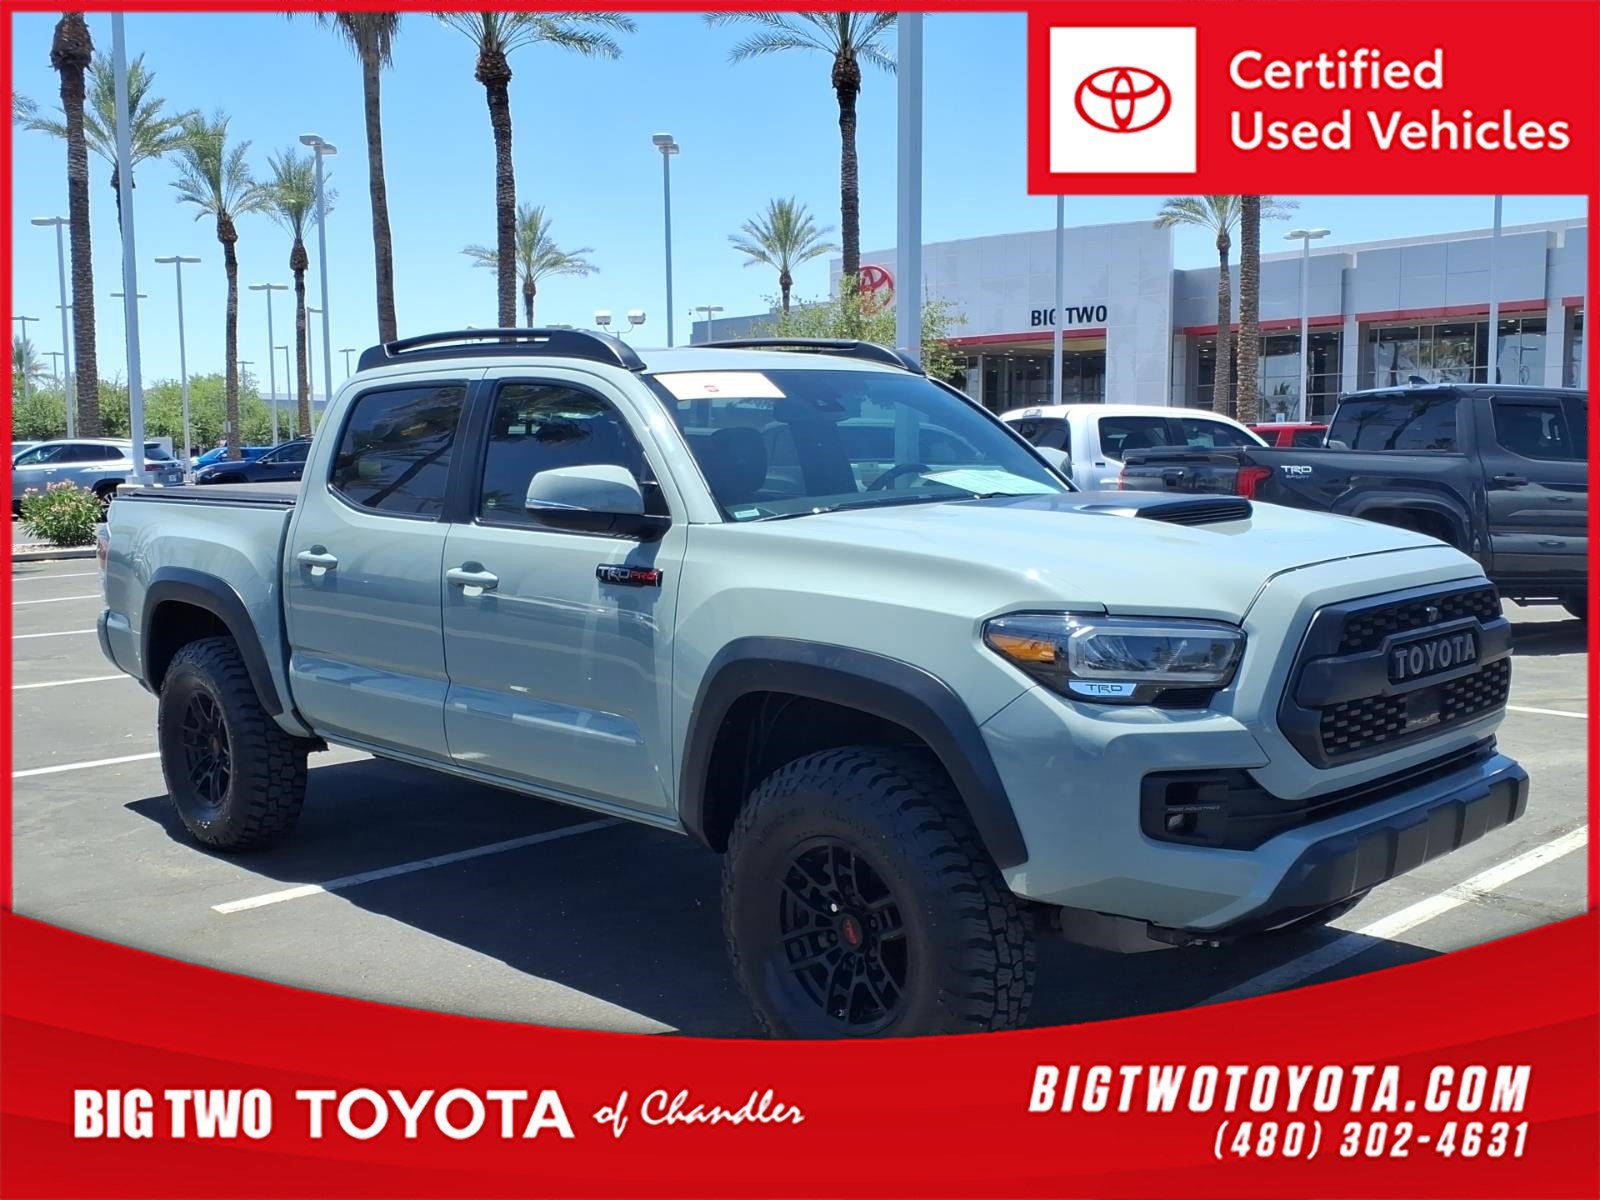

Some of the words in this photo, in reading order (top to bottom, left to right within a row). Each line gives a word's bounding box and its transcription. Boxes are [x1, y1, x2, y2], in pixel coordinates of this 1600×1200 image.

[1065, 305, 1107, 324] TWO
[1280, 465, 1312, 475] TRD
[1395, 633, 1476, 678] TOYOTA
[1085, 683, 1123, 694] TRD
